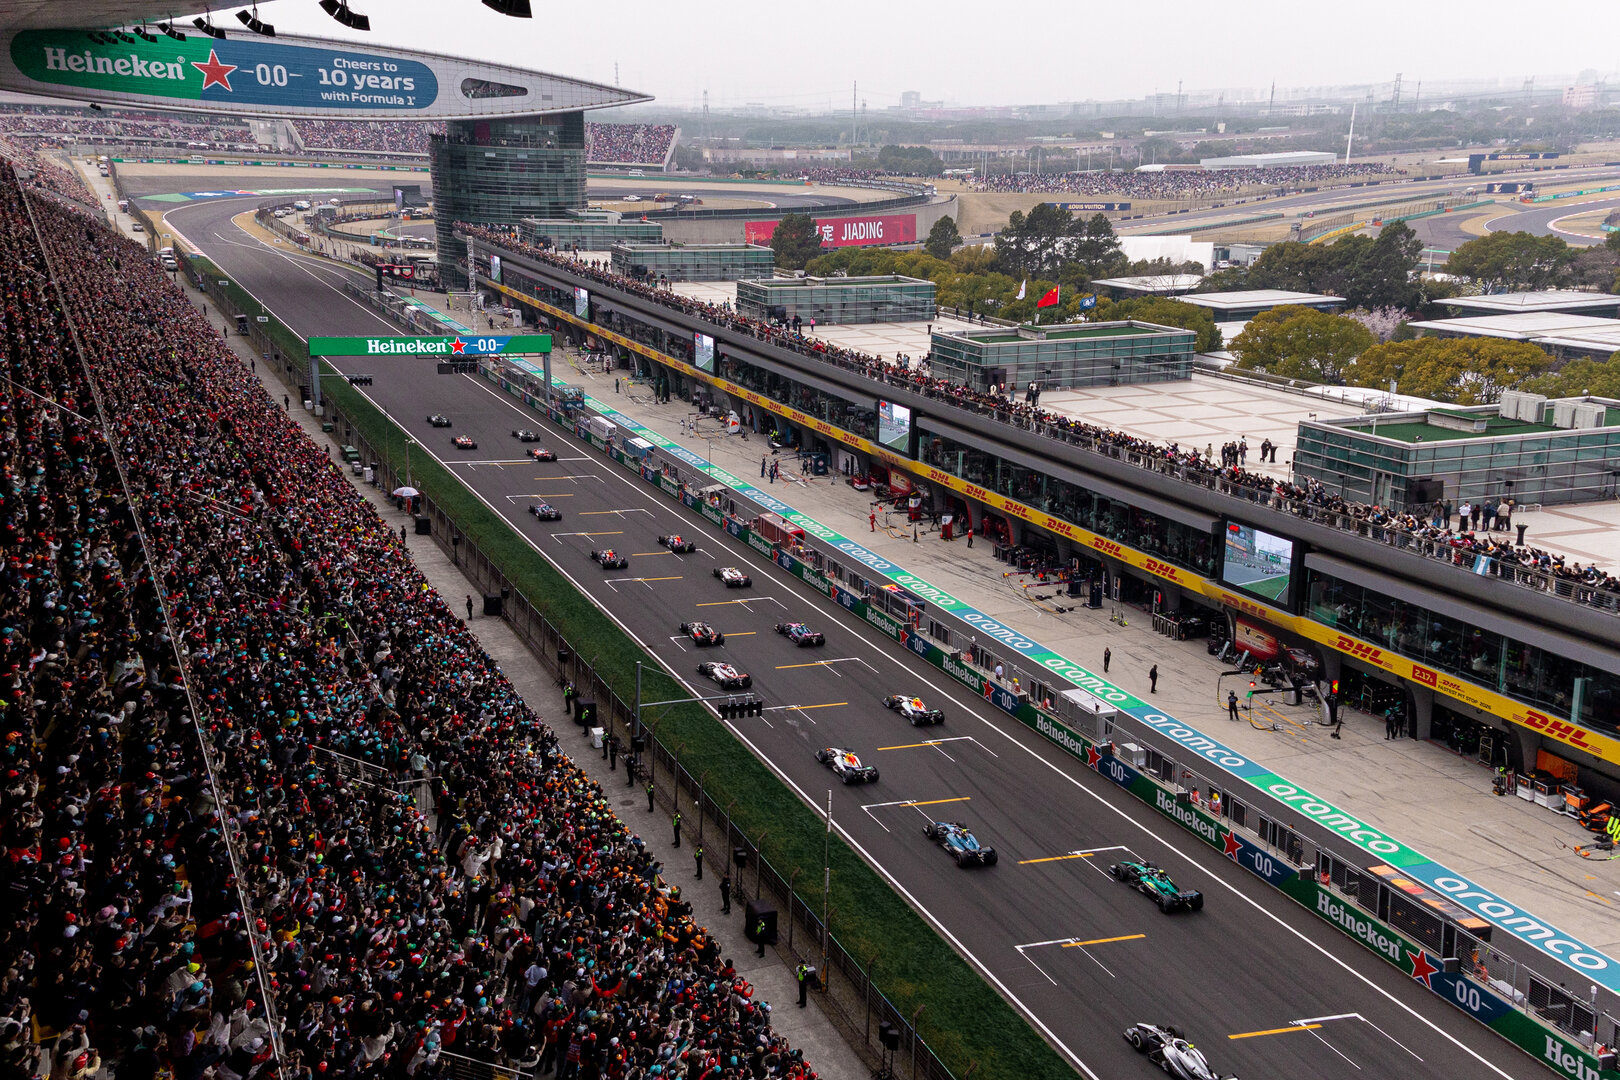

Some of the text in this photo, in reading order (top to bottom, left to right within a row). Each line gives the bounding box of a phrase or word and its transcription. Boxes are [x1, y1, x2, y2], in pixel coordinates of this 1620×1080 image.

[333, 58, 397, 72] Cheers to
[318, 68, 415, 91] 10 years
[321, 91, 349, 102] with
[352, 92, 405, 105] Formula
[841, 221, 883, 241] JIADING
[747, 392, 759, 404] DHL
[768, 401, 782, 414] DHL
[792, 411, 806, 425] DHL
[816, 422, 831, 436] DHL
[843, 432, 859, 448] DHL
[930, 469, 950, 486] DHL
[965, 484, 987, 502] DHL
[1004, 500, 1029, 519] DHL
[789, 514, 835, 538] aramco
[1047, 517, 1073, 539] DHL
[839, 543, 890, 569] aramco
[1094, 536, 1122, 558] DHL
[1146, 558, 1178, 581] DHL
[896, 575, 956, 605] aramco
[1222, 593, 1273, 622] DHL
[866, 607, 897, 637] Heineken
[964, 613, 1033, 649] aramco
[1336, 635, 1384, 665] DHL
[942, 655, 979, 689] Heineken
[1045, 659, 1127, 701] aramco
[1438, 685, 1457, 696] FASTEST
[1465, 695, 1478, 704] STOP
[1442, 679, 1461, 691] DHL
[1036, 714, 1082, 755] Heineken
[1524, 709, 1590, 748] DHL
[1144, 714, 1245, 767] aramco
[1156, 789, 1216, 842] Heineken
[1269, 784, 1400, 853] aramco
[1317, 891, 1401, 961] Heineken
[1434, 877, 1608, 970] aramco
